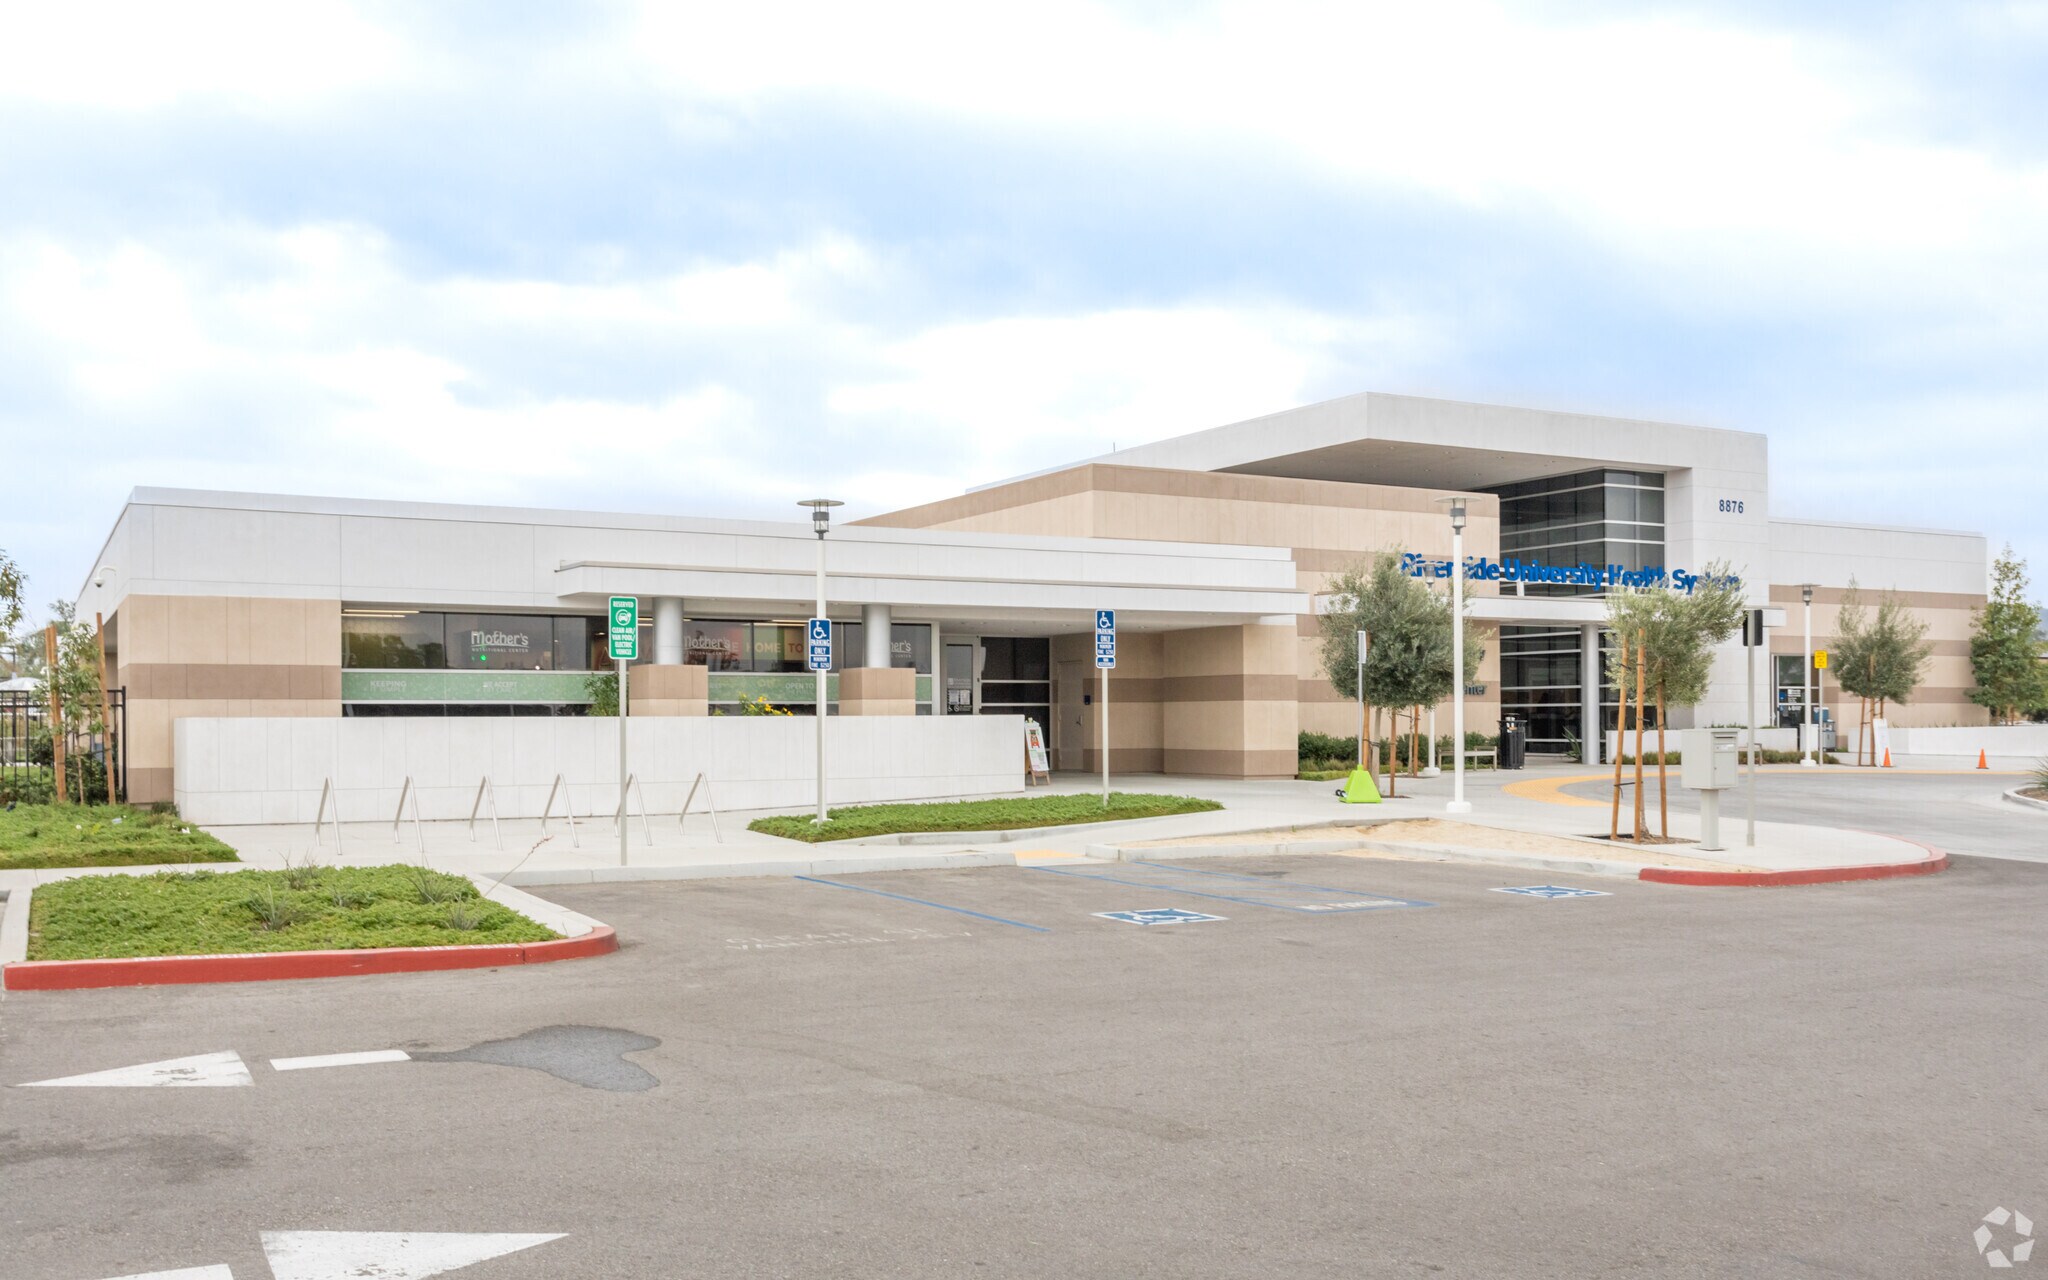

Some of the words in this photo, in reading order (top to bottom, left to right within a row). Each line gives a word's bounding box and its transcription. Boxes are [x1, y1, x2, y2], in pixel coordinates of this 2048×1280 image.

[1719, 499, 1744, 514] 8876
[1400, 553, 1500, 580] Rieride
[1504, 558, 1604, 591] University
[1608, 564, 1669, 588] Health
[471, 631, 529, 646] Mother's
[788, 643, 804, 653] TO
[814, 646, 827, 655] ONLY
[369, 680, 407, 688] KEEPING
[785, 682, 804, 690] OPEN
[1463, 684, 1488, 695] enter
